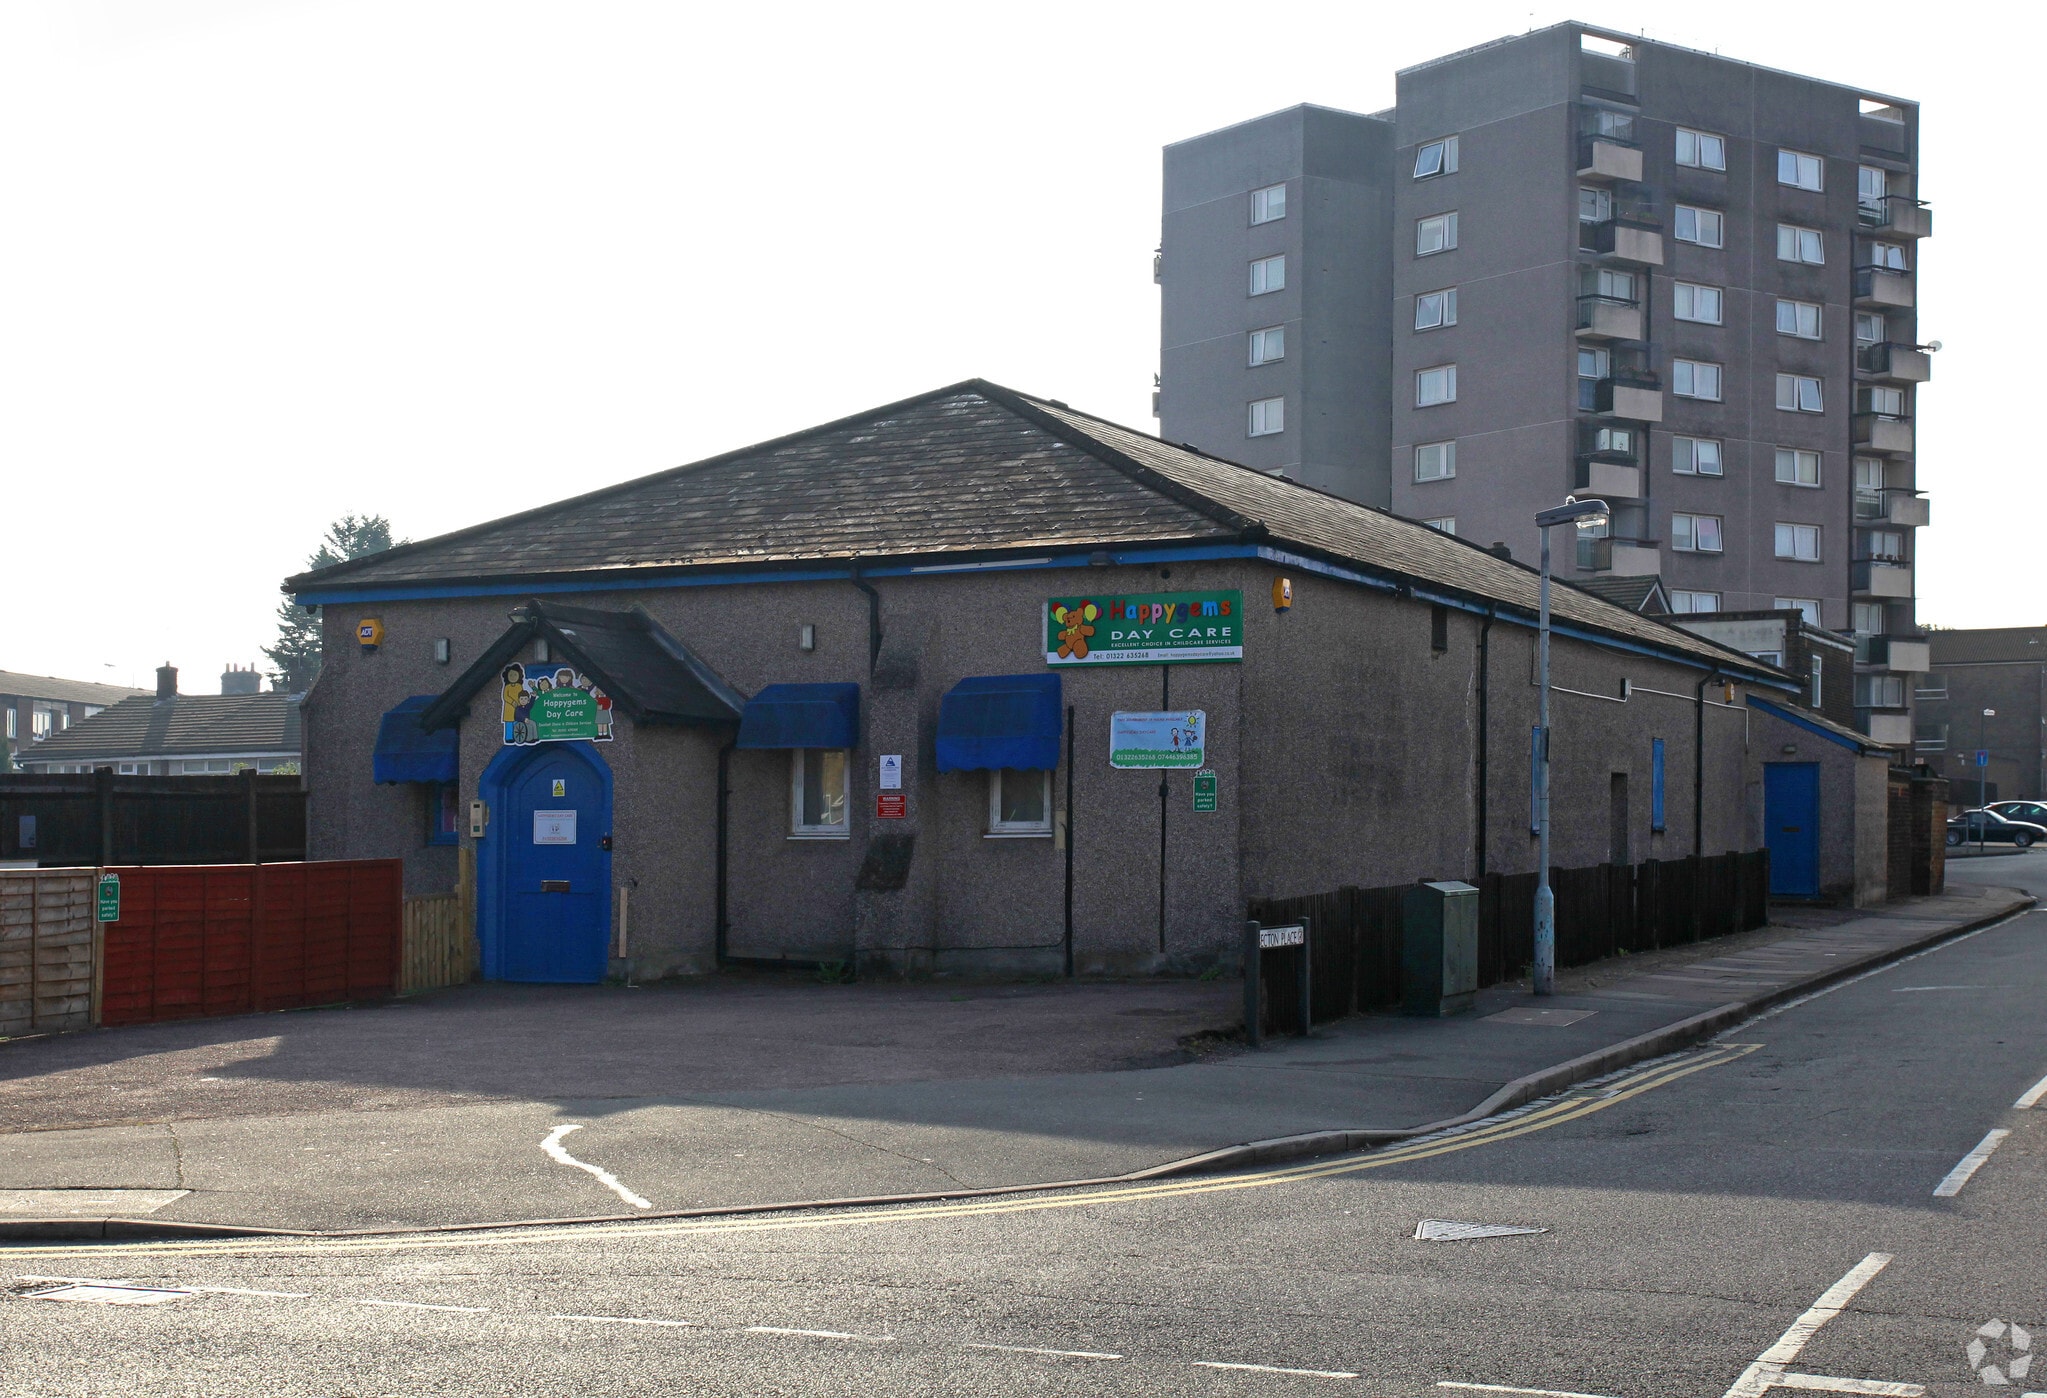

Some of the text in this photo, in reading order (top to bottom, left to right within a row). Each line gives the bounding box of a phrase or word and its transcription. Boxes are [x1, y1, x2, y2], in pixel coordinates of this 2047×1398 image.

[1110, 600, 1231, 625] Happygems
[361, 628, 372, 636] ADT
[1111, 626, 1232, 640] DAY CARE
[544, 699, 586, 708] Happygems
[547, 711, 561, 719] Day
[1281, 931, 1297, 945] PLACE
